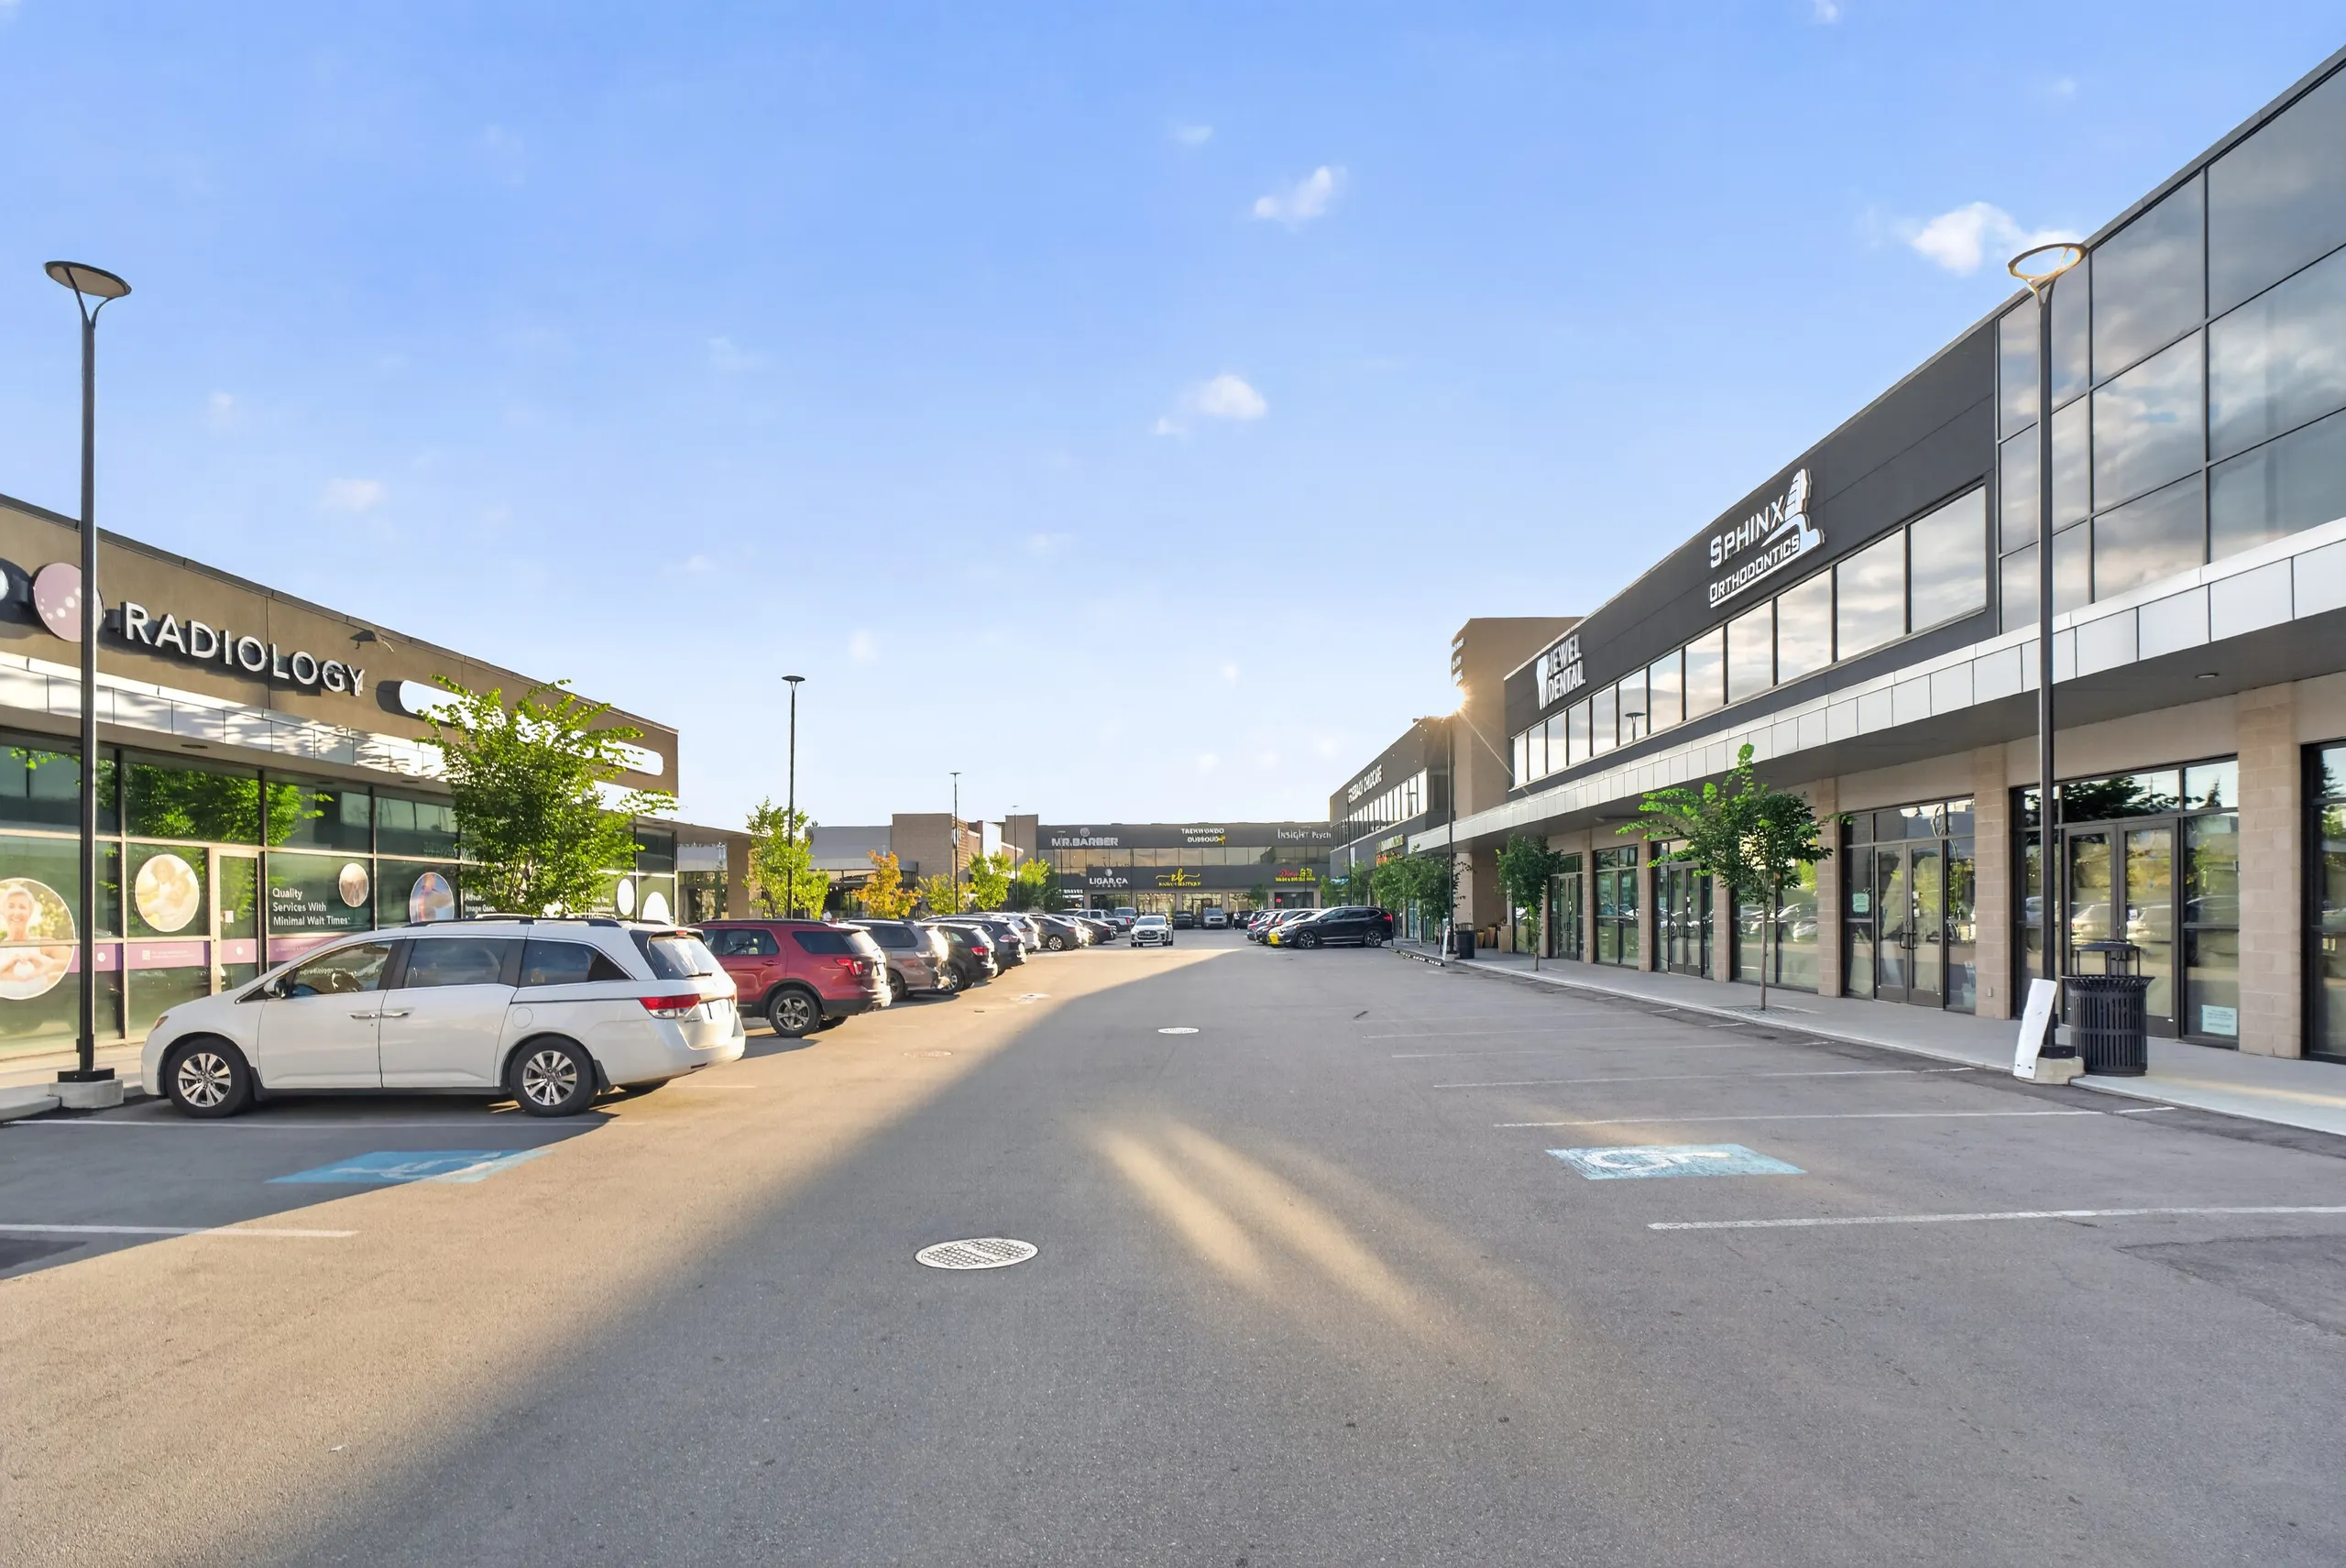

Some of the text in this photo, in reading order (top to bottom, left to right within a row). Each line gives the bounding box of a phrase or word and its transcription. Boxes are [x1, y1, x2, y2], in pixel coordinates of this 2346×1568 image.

[1710, 494, 1785, 569] SPHINX
[1709, 533, 1801, 603] ORTHODONTICS
[121, 601, 366, 696] RADIOLOGY
[1548, 660, 1586, 705] DENTAL
[272, 887, 302, 901] Quality
[272, 901, 327, 913] Services With
[273, 916, 305, 927] Minimal
[305, 915, 326, 926] Wait
